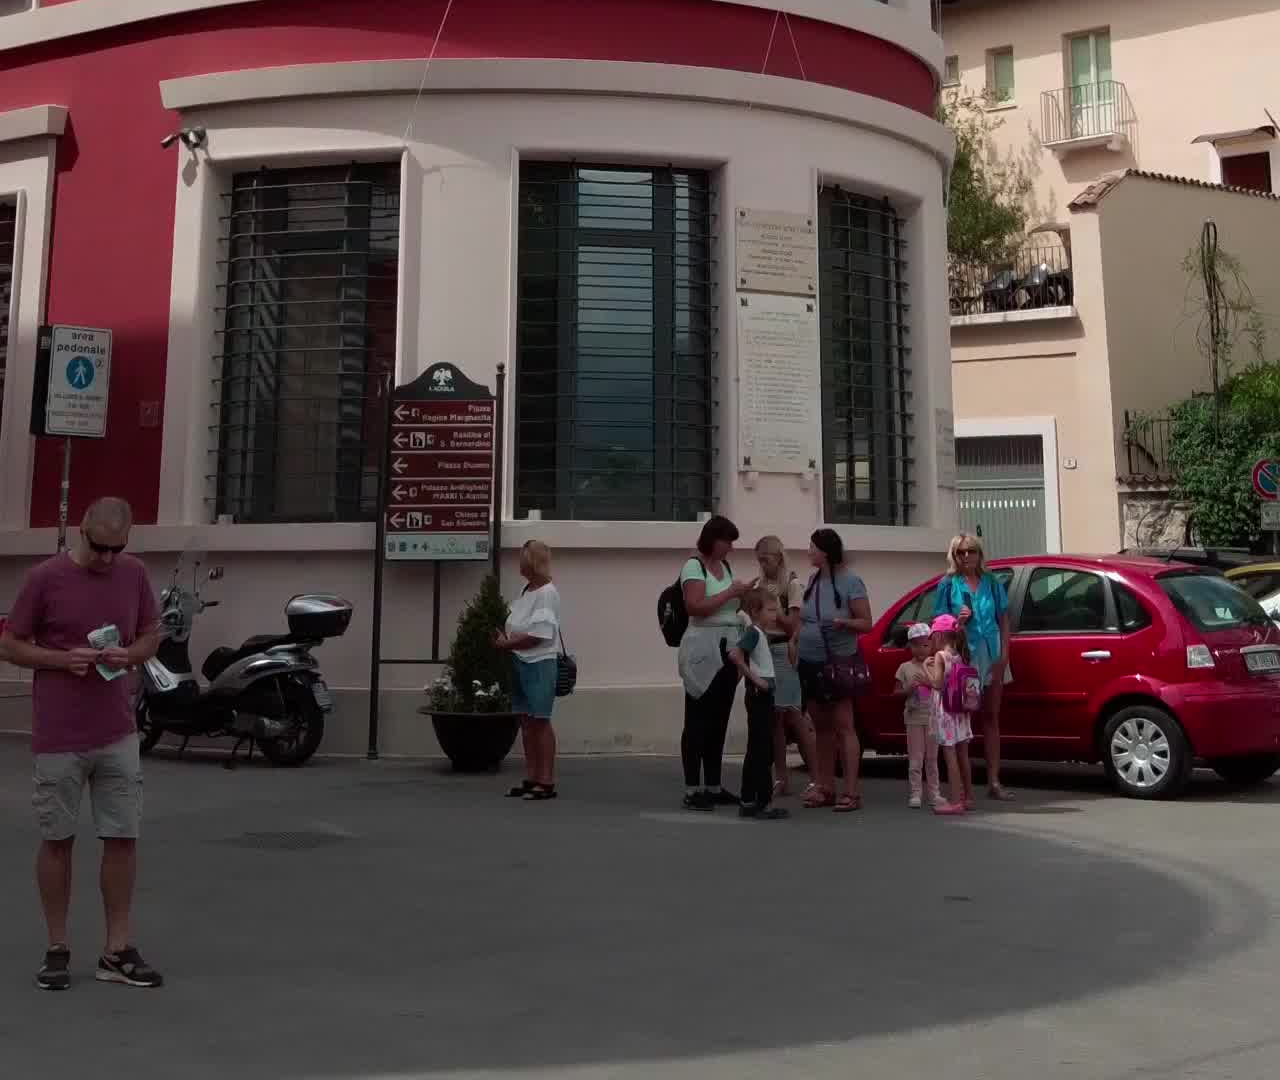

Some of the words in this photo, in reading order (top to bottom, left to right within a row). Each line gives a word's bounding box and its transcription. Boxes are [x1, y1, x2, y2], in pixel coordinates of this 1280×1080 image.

[71, 332, 94, 342] area
[56, 342, 105, 356] pedonale
[468, 405, 491, 413] Piazza
[422, 415, 448, 424] Regina
[449, 414, 491, 424] Margherita
[450, 440, 491, 450] Bernardino
[438, 461, 461, 469] Piazza
